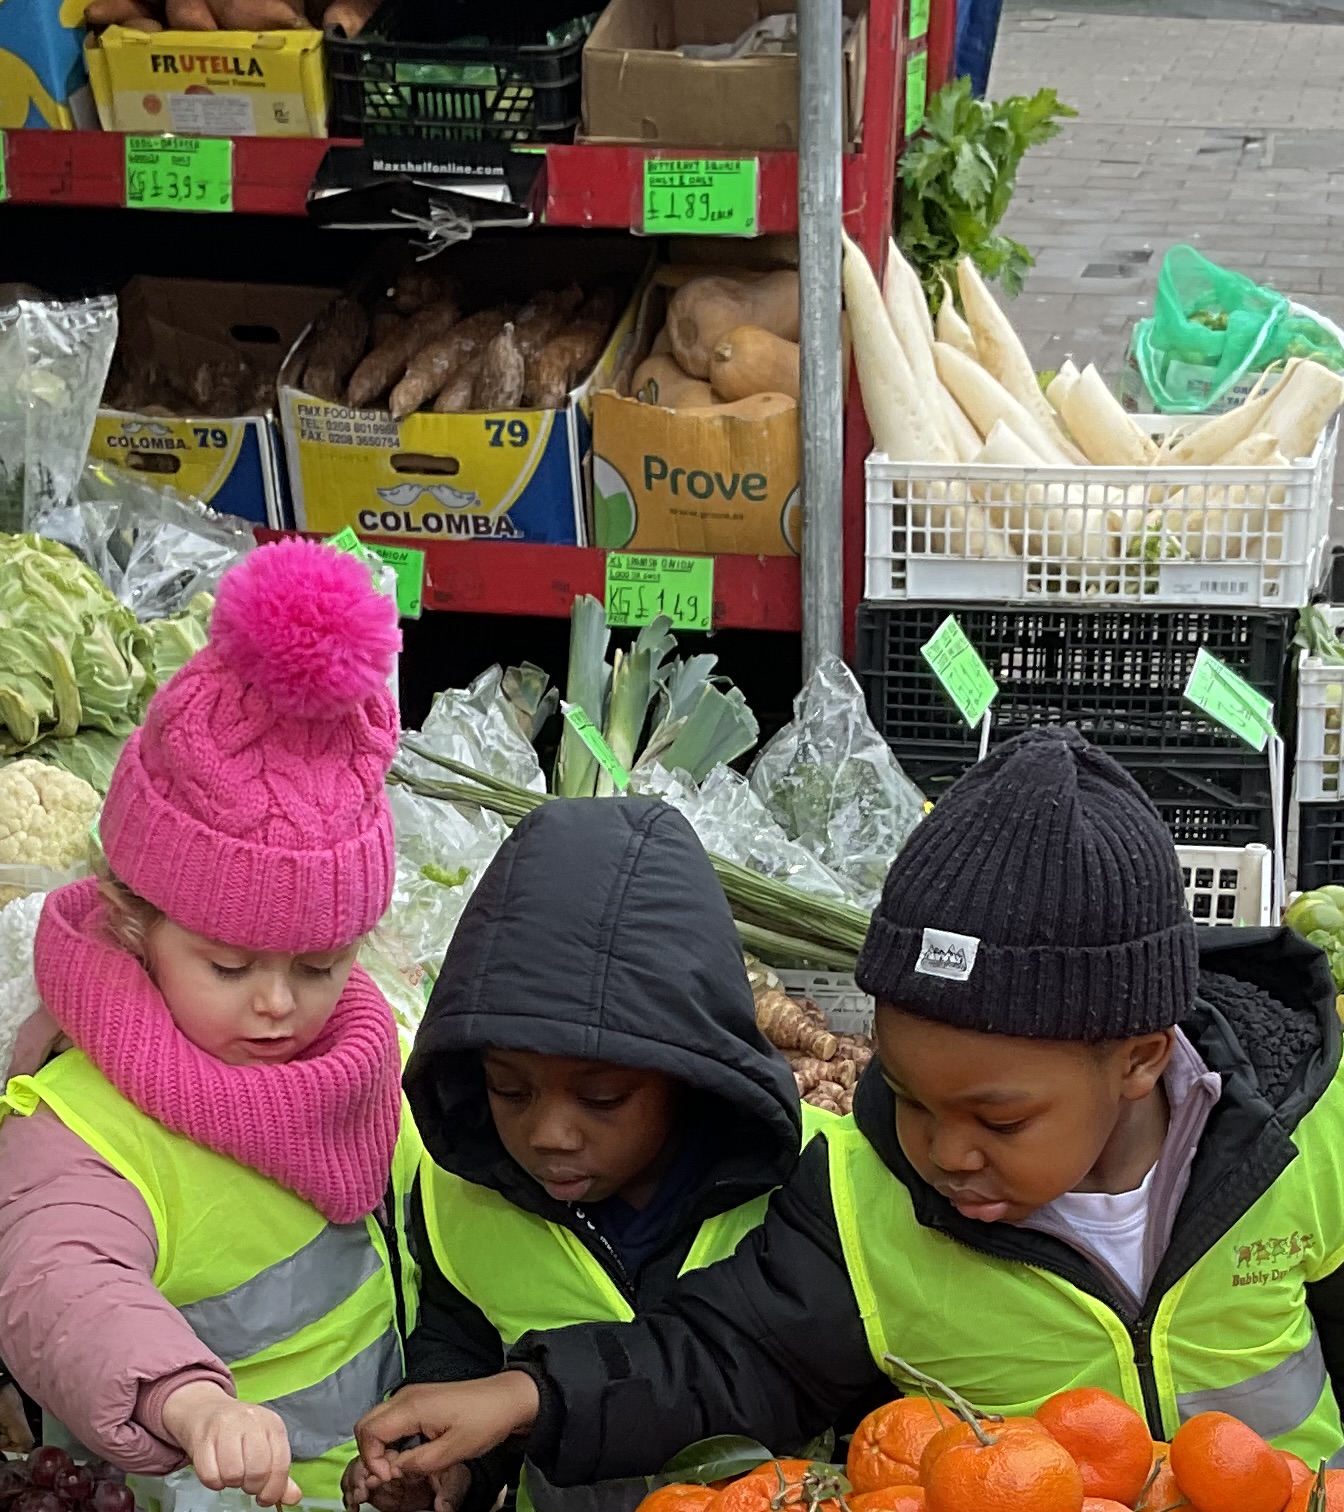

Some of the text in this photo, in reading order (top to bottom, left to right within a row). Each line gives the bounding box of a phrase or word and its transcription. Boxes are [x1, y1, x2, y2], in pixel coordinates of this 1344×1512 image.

[151, 54, 265, 77] FRUTELLA
[372, 159, 504, 175] Maxshelfonline.com
[324, 407, 356, 420] FOOD
[359, 411, 376, 421] CO
[106, 435, 187, 450] COLOMBA
[193, 427, 229, 448] 79
[484, 419, 530, 447] 79
[643, 454, 768, 502] Prove
[358, 509, 515, 538] COLOMBA
[661, 559, 694, 571] ONION
[608, 584, 633, 615] KG
[1231, 1270, 1270, 1287] Bubbly
